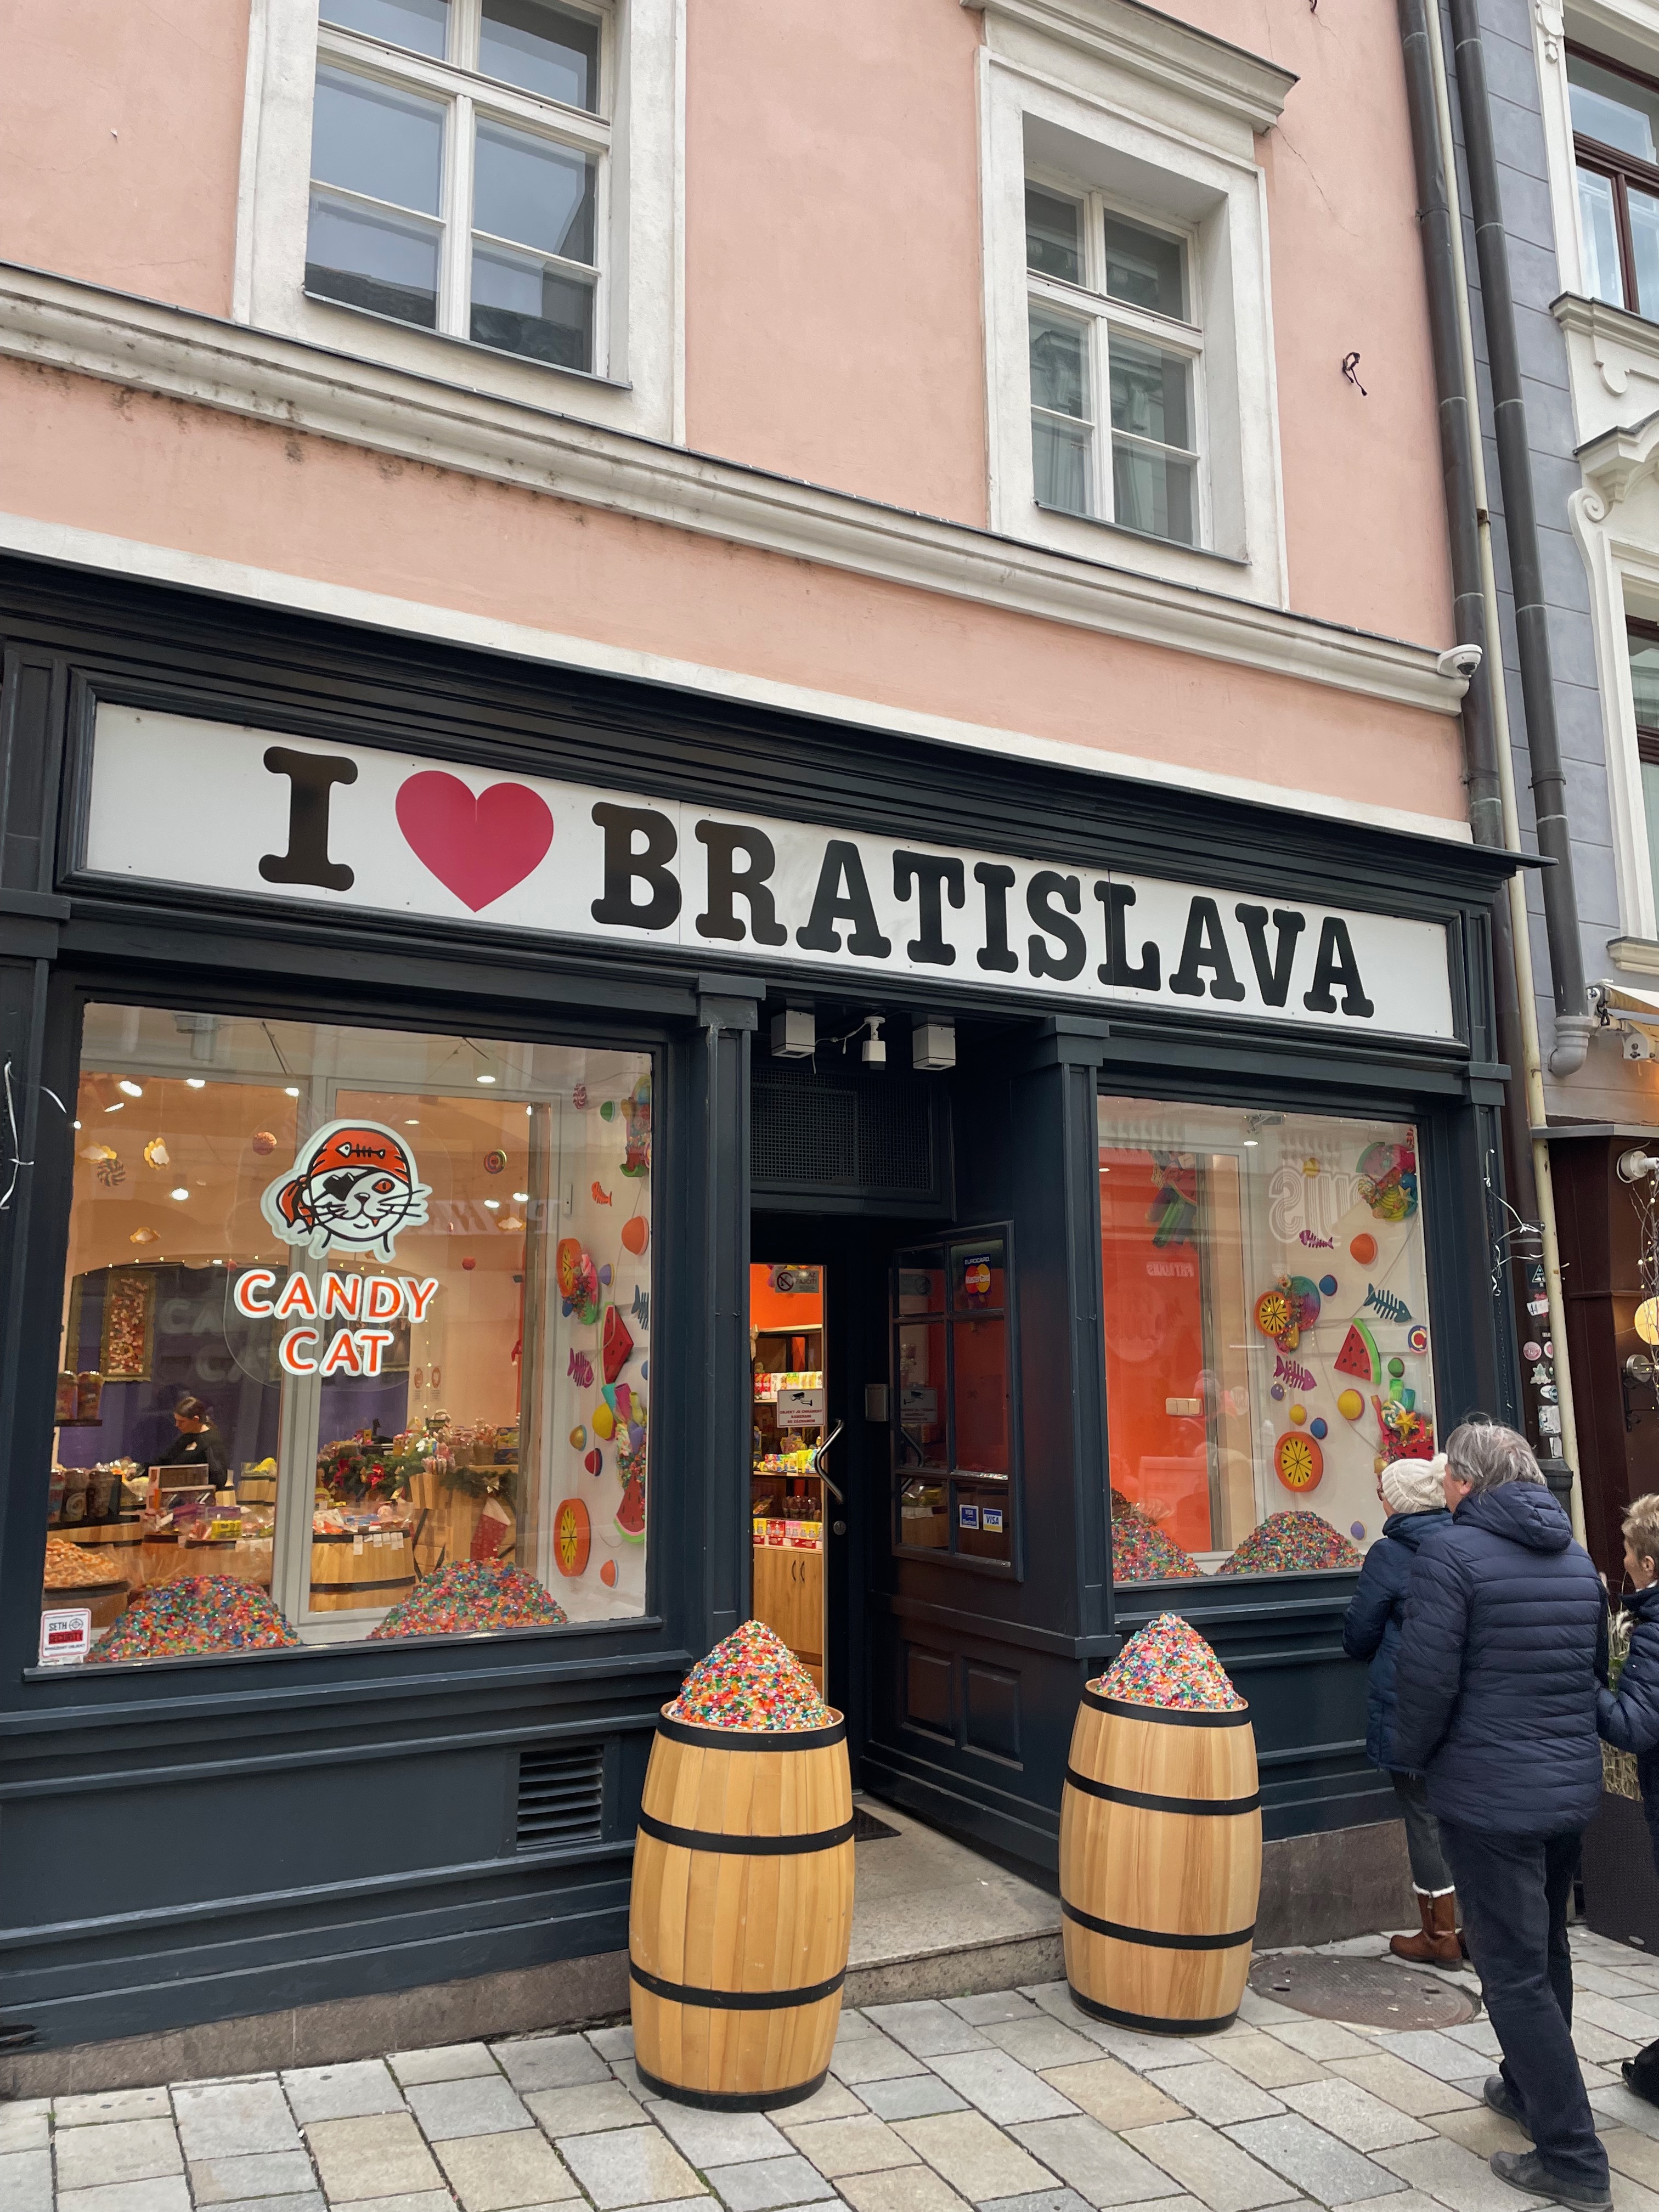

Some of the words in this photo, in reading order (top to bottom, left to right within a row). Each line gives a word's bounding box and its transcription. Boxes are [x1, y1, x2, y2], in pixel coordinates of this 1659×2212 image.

[258, 746, 358, 891] I
[591, 801, 1374, 1018] BRATISLAVA
[964, 1256, 990, 1265] EUROCARD
[234, 1269, 439, 1324] CANDY
[279, 1326, 394, 1376] CAT
[986, 1515, 999, 1525] VISA
[49, 1622, 67, 1631] SETH
